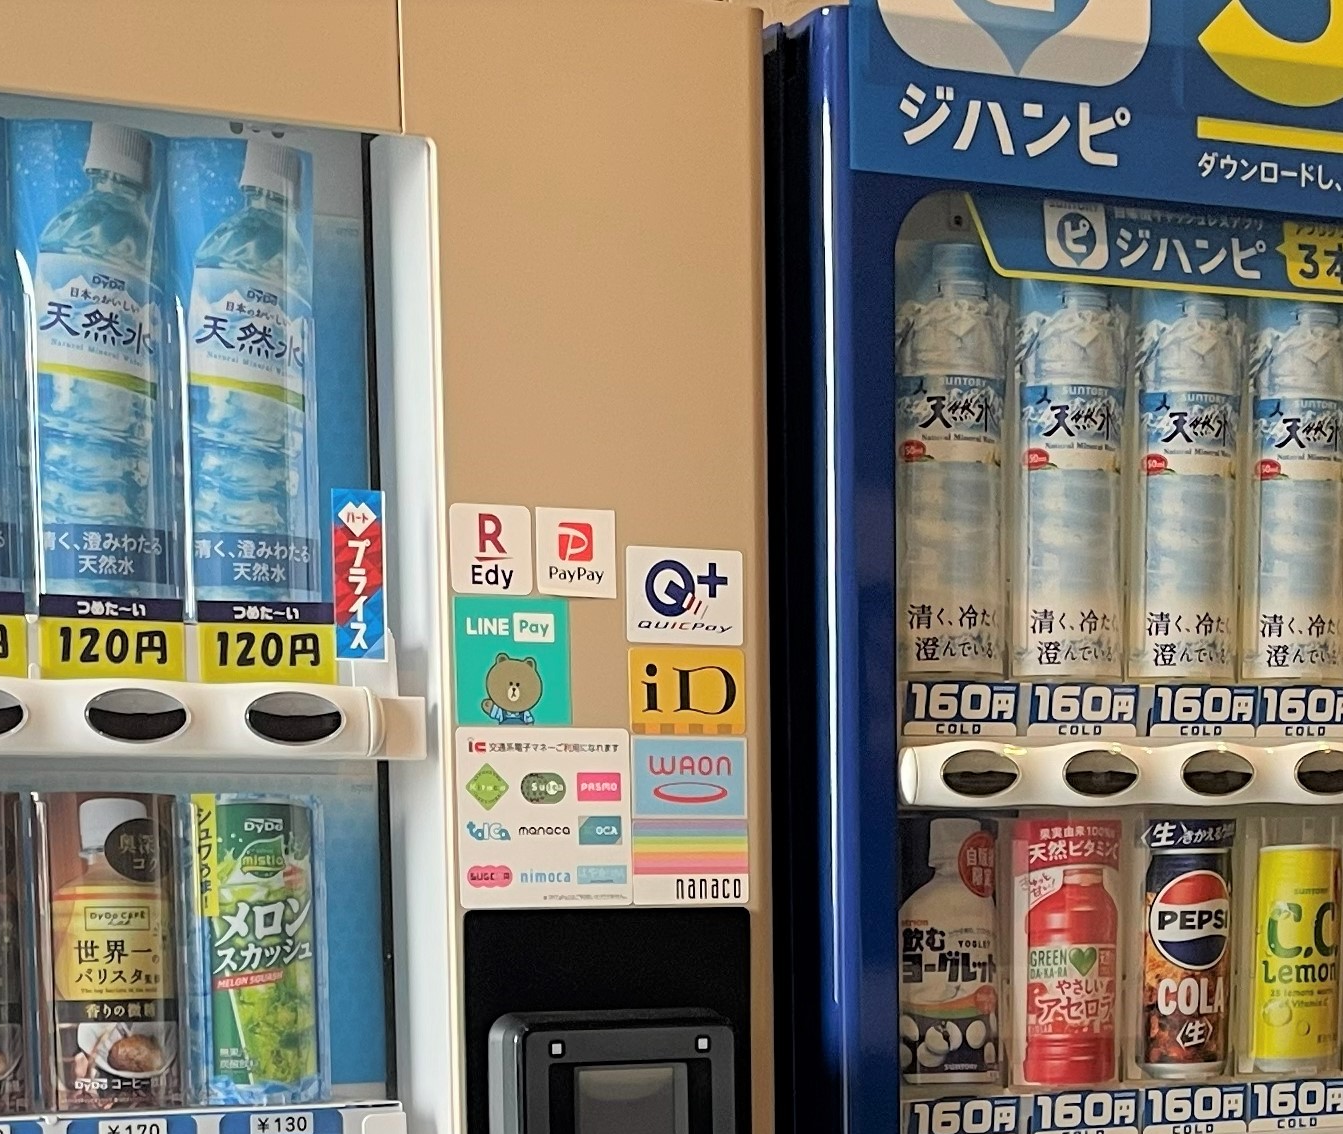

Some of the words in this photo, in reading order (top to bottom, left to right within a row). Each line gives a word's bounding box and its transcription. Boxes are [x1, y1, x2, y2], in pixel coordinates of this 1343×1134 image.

[899, 79, 1131, 168] ジハンピ
[1115, 227, 1267, 279] ジハンピ
[196, 315, 306, 370] 天然水
[471, 564, 514, 590] Edy
[549, 566, 605, 584] PayPay
[345, 539, 369, 652] プライス
[466, 617, 510, 636] LINE
[518, 620, 550, 638] Pay
[216, 630, 322, 668] 120円
[641, 663, 737, 715] iD
[912, 684, 1013, 718] 160円
[1036, 686, 1137, 720] 160円
[936, 723, 981, 736] COLD
[1058, 723, 1103, 737] COLD
[649, 755, 732, 776] WAON
[580, 782, 618, 792] PASMO
[518, 825, 571, 836] manaca
[520, 868, 571, 884] nimoca
[676, 877, 742, 900] nanaco
[214, 897, 312, 948] メロン
[213, 938, 313, 975] スカッシュ
[1030, 949, 1068, 967] GREEN
[1157, 979, 1225, 1016] COLA
[256, 1115, 308, 1134] ¥130
[1038, 1093, 1136, 1130] 160円
